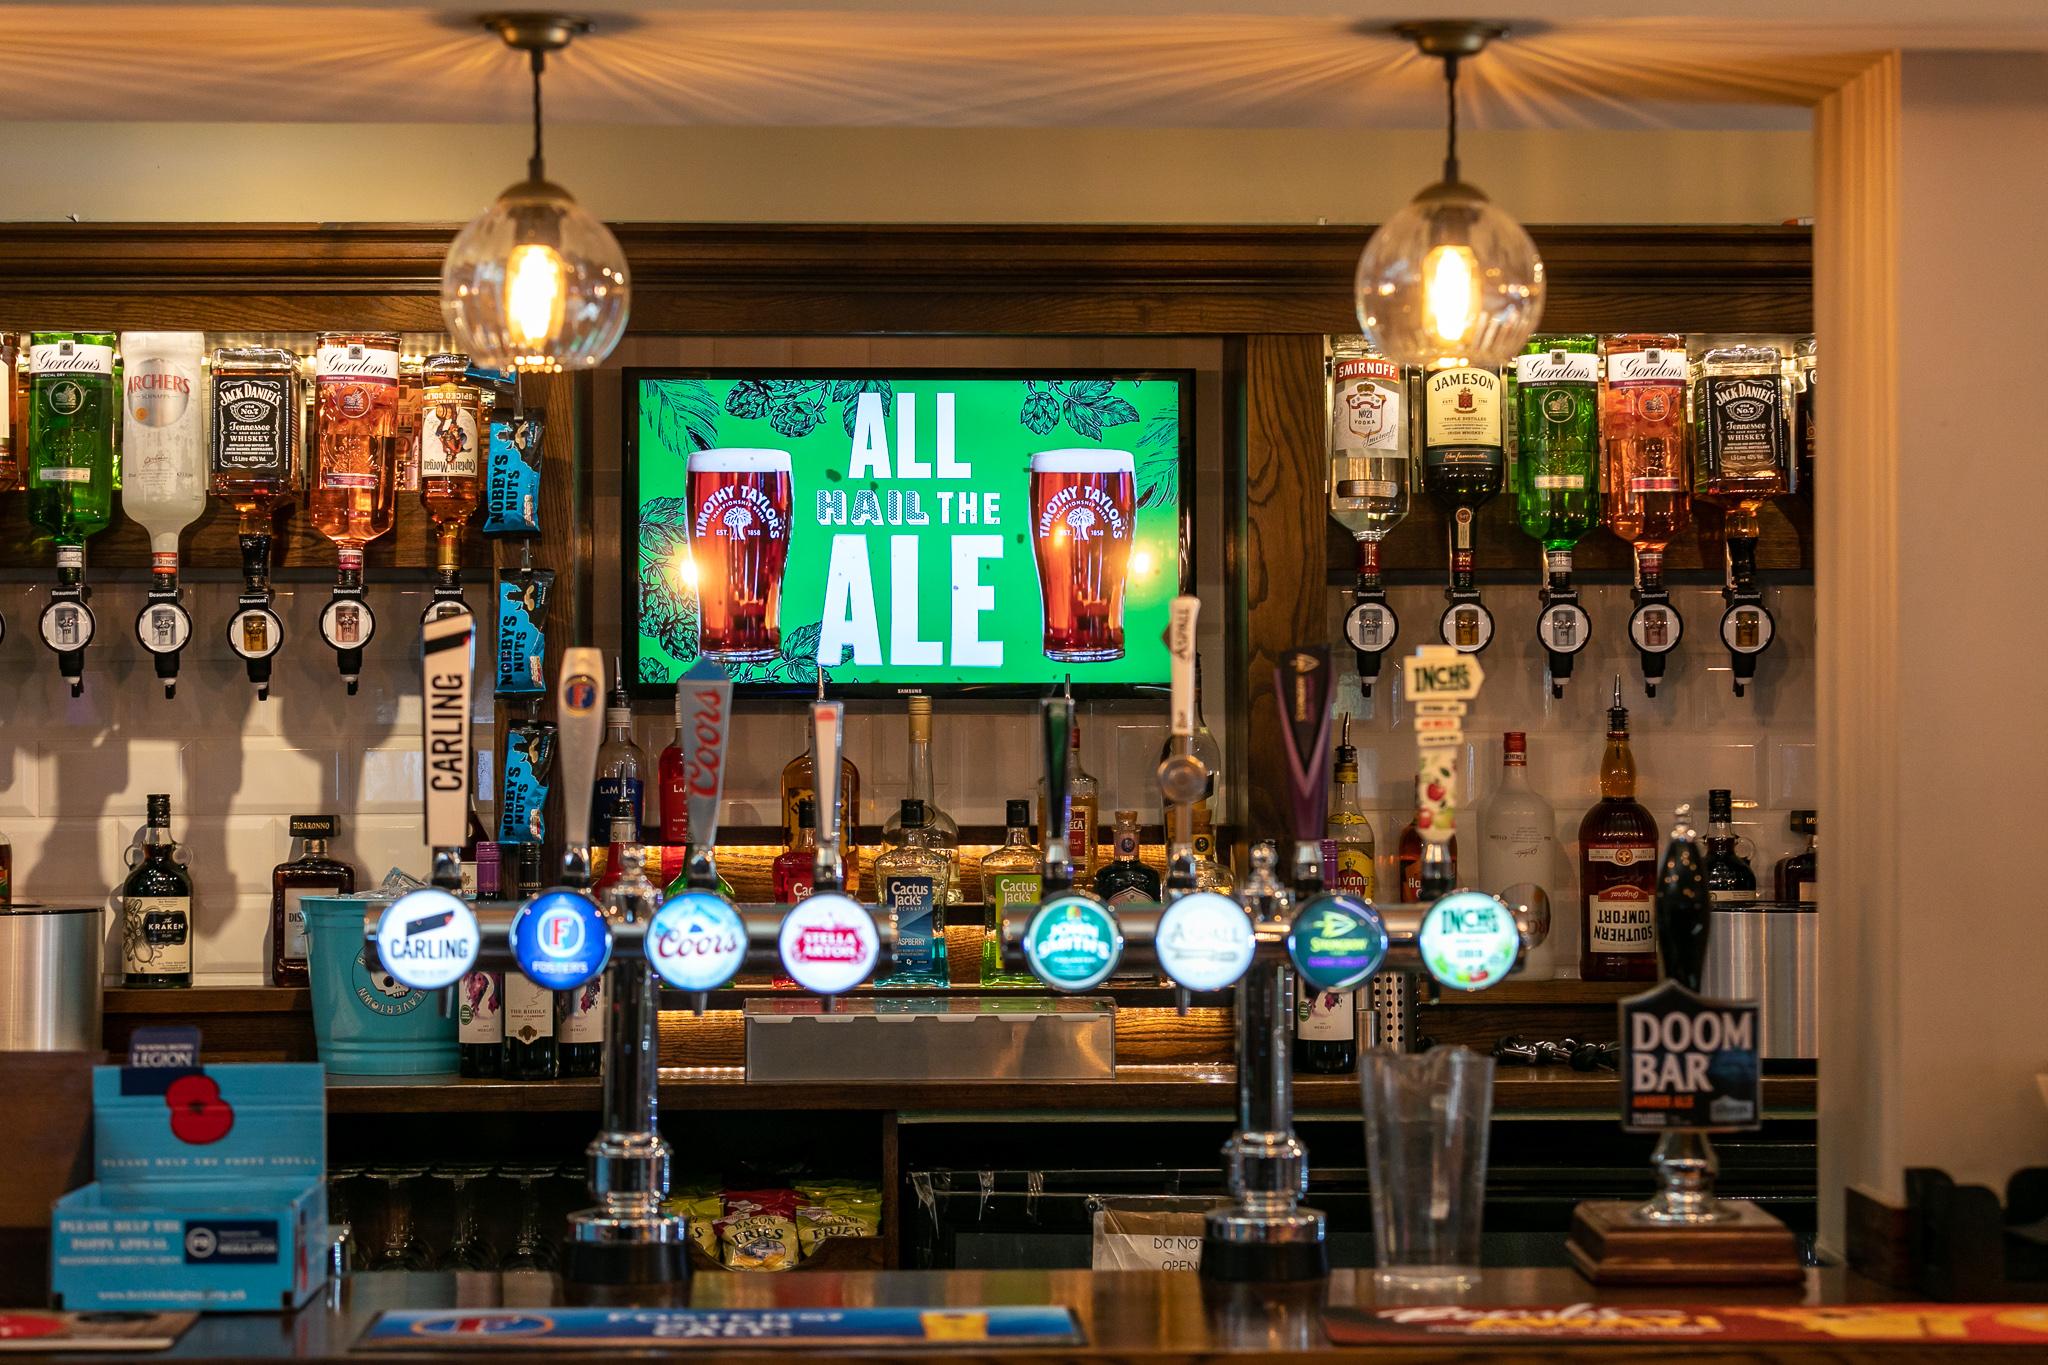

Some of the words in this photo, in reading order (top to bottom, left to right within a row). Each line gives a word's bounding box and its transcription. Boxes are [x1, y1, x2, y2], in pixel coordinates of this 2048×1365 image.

[36, 351, 101, 371] Gordon's
[324, 353, 389, 375] Gordon's
[1526, 359, 1590, 379] Gordon's
[1620, 358, 1683, 378] Gordon's
[127, 374, 191, 396] ARCHERS
[1434, 373, 1495, 392] JAMESON
[219, 386, 245, 406] JACK
[244, 383, 283, 406] DANIEL'S
[1715, 387, 1739, 406] JACK
[1738, 383, 1776, 405] DANIEL'S
[229, 421, 271, 431] Tennessee
[848, 392, 972, 479] ALL
[1726, 421, 1766, 430] Tennessee
[423, 459, 448, 473] Morgan
[450, 460, 476, 474] Captain
[490, 454, 509, 524] NOBBY'S
[506, 470, 520, 511] NUTS
[696, 485, 735, 538] TIMOTHY
[741, 485, 782, 539] TAYLOR'S
[711, 500, 752, 522] CHAMPIONSHIP
[816, 489, 930, 526] HAIL
[937, 492, 1000, 525] THE
[1039, 485, 1078, 538] TIMOTHY
[1084, 485, 1126, 539] TAYLOR'S
[1054, 500, 1095, 522] CHAMPIONSHIP
[818, 534, 1004, 667] ALE
[500, 615, 518, 686] NOBBY'S
[514, 631, 527, 673] NUTS
[431, 673, 463, 792] CARLING
[689, 688, 722, 798] Coors
[504, 766, 521, 836] NOBBY'S
[515, 783, 529, 824] NUTS
[293, 822, 330, 830] DISARONNO
[891, 881, 928, 896] Cactus
[1000, 879, 1038, 892] Cactus
[1610, 890, 1639, 899] Original
[895, 894, 922, 909] Jack's
[1004, 891, 1031, 904] Jack's
[1597, 910, 1650, 924] COMFORT
[658, 930, 738, 958] Coors
[896, 937, 926, 946] ASPBERRY
[1593, 925, 1652, 942] SOUTHERN
[390, 937, 470, 960] CARLING
[1631, 1011, 1753, 1052] DOOM
[132, 1052, 193, 1068] LEGION
[1631, 1052, 1713, 1093] BAR
[734, 1217, 777, 1231] BACON
[812, 1225, 865, 1240] FRIES
[732, 1228, 784, 1246] FRIES
[1153, 1237, 1174, 1250] DO
[1161, 1260, 1198, 1272] OPEN
